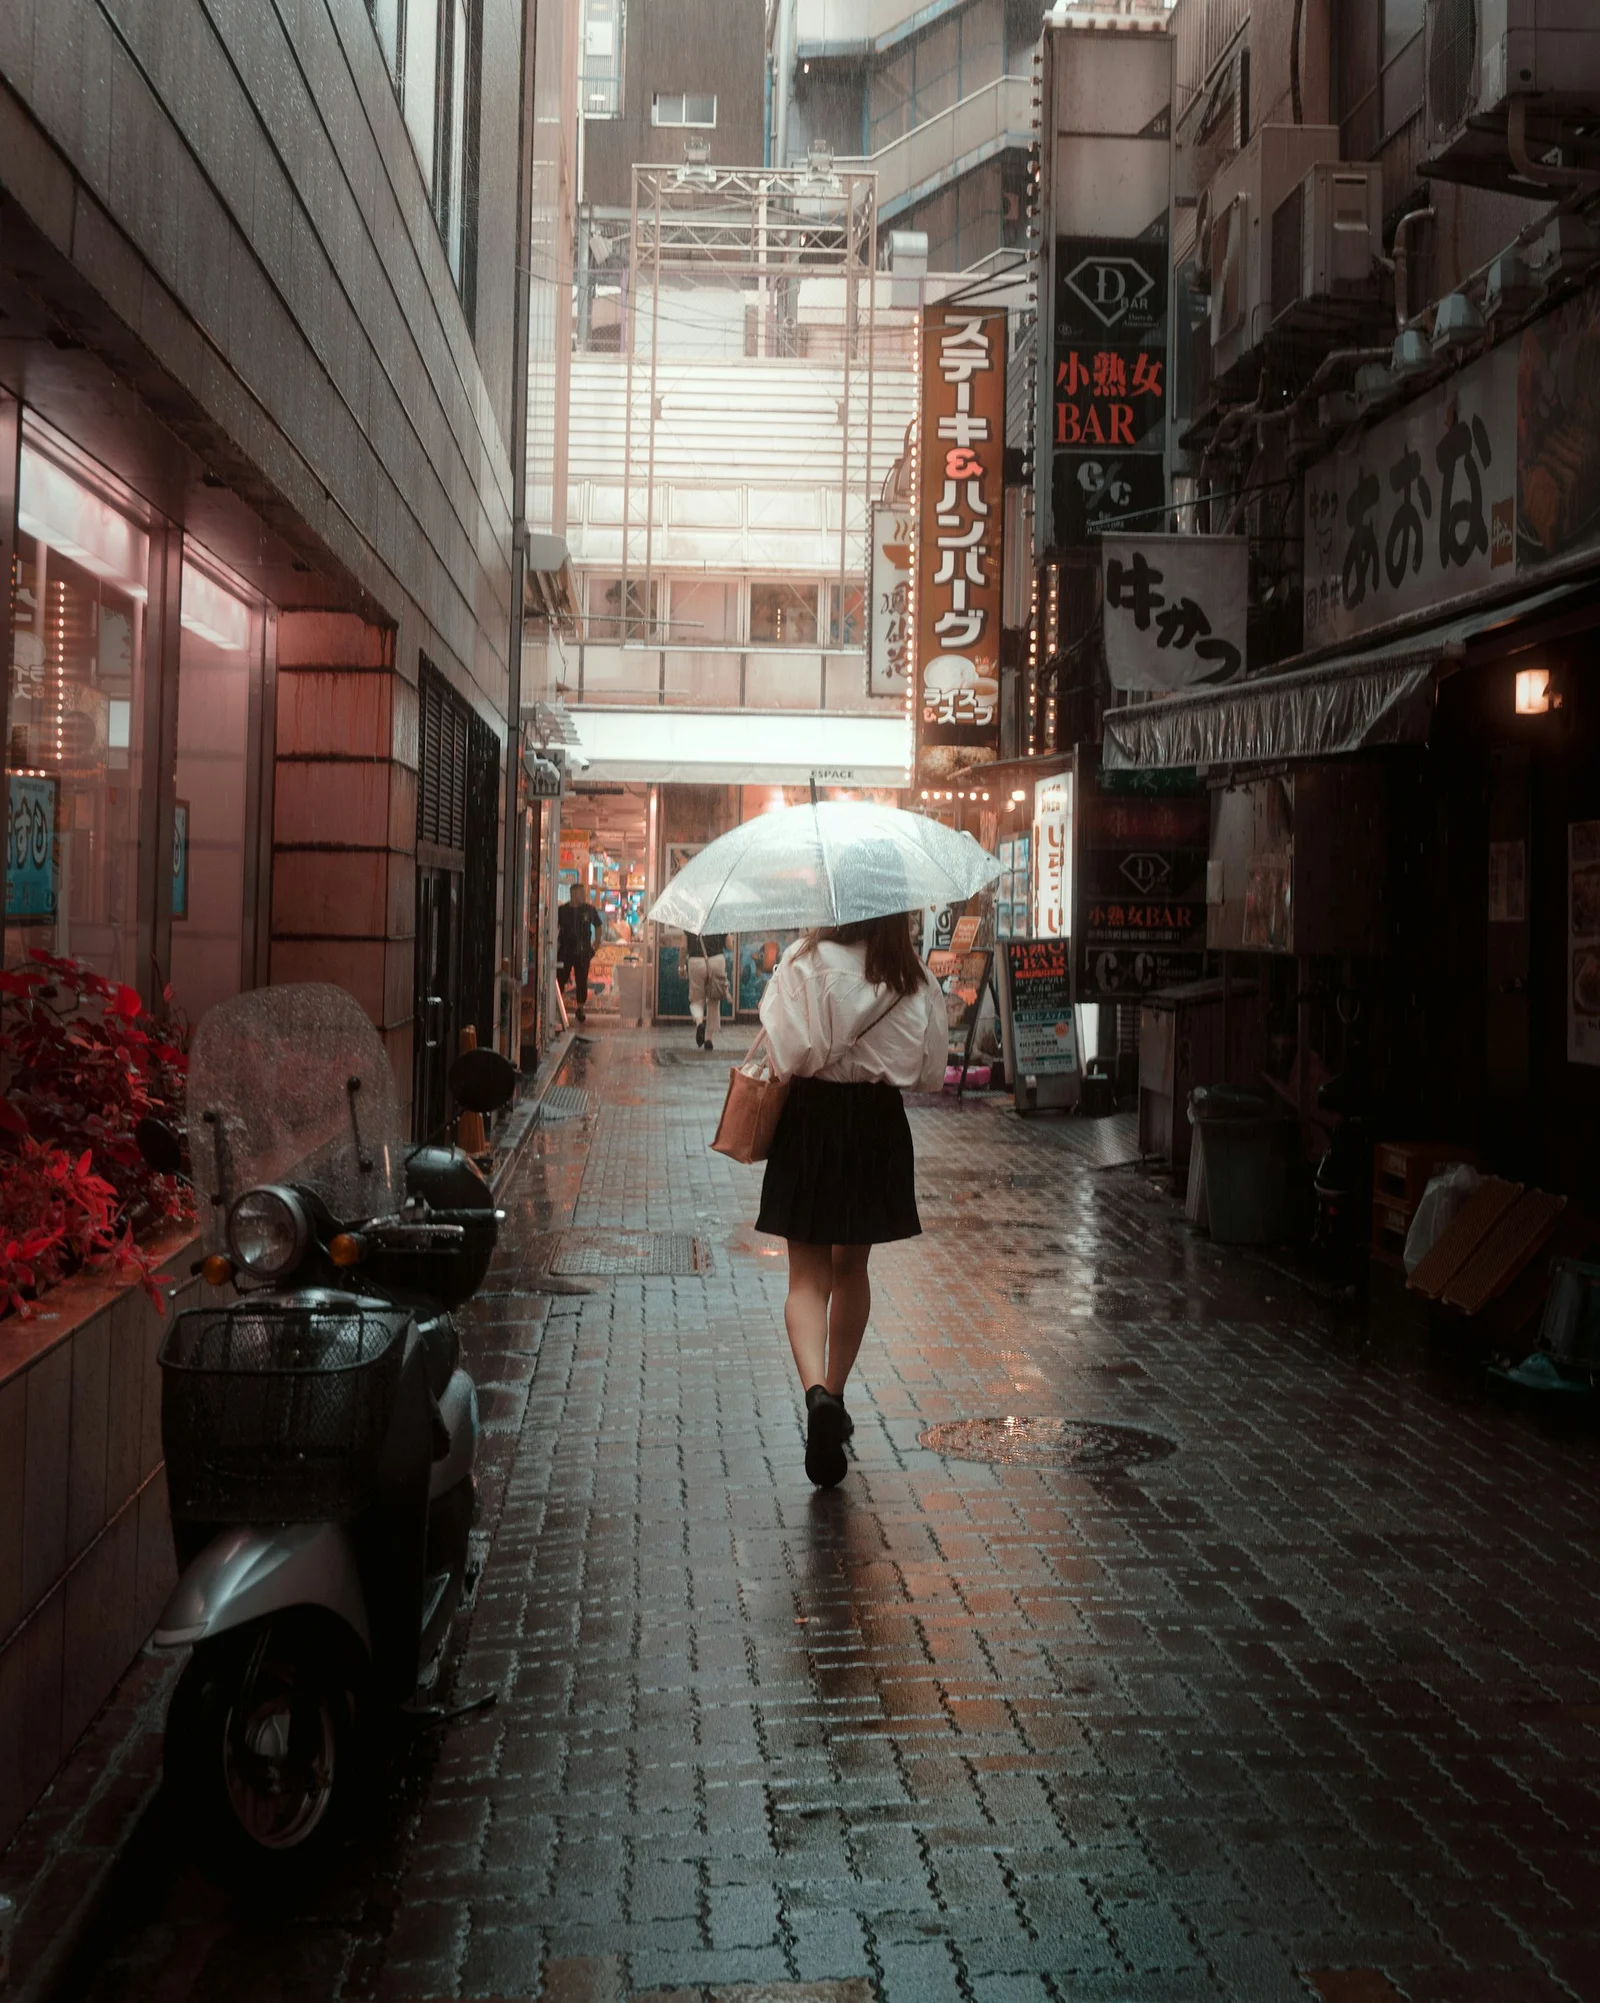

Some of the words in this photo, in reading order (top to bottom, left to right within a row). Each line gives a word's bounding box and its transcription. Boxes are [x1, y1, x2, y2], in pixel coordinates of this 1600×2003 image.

[1120, 298, 1148, 311] BAR
[1056, 351, 1163, 397] 小熟女
[1055, 402, 1137, 445] BAR
[934, 315, 990, 648] ステーキ&ハンバーグ
[1105, 551, 1242, 686] 牛かつ
[923, 687, 977, 708] ライス
[923, 706, 994, 726] &スープ
